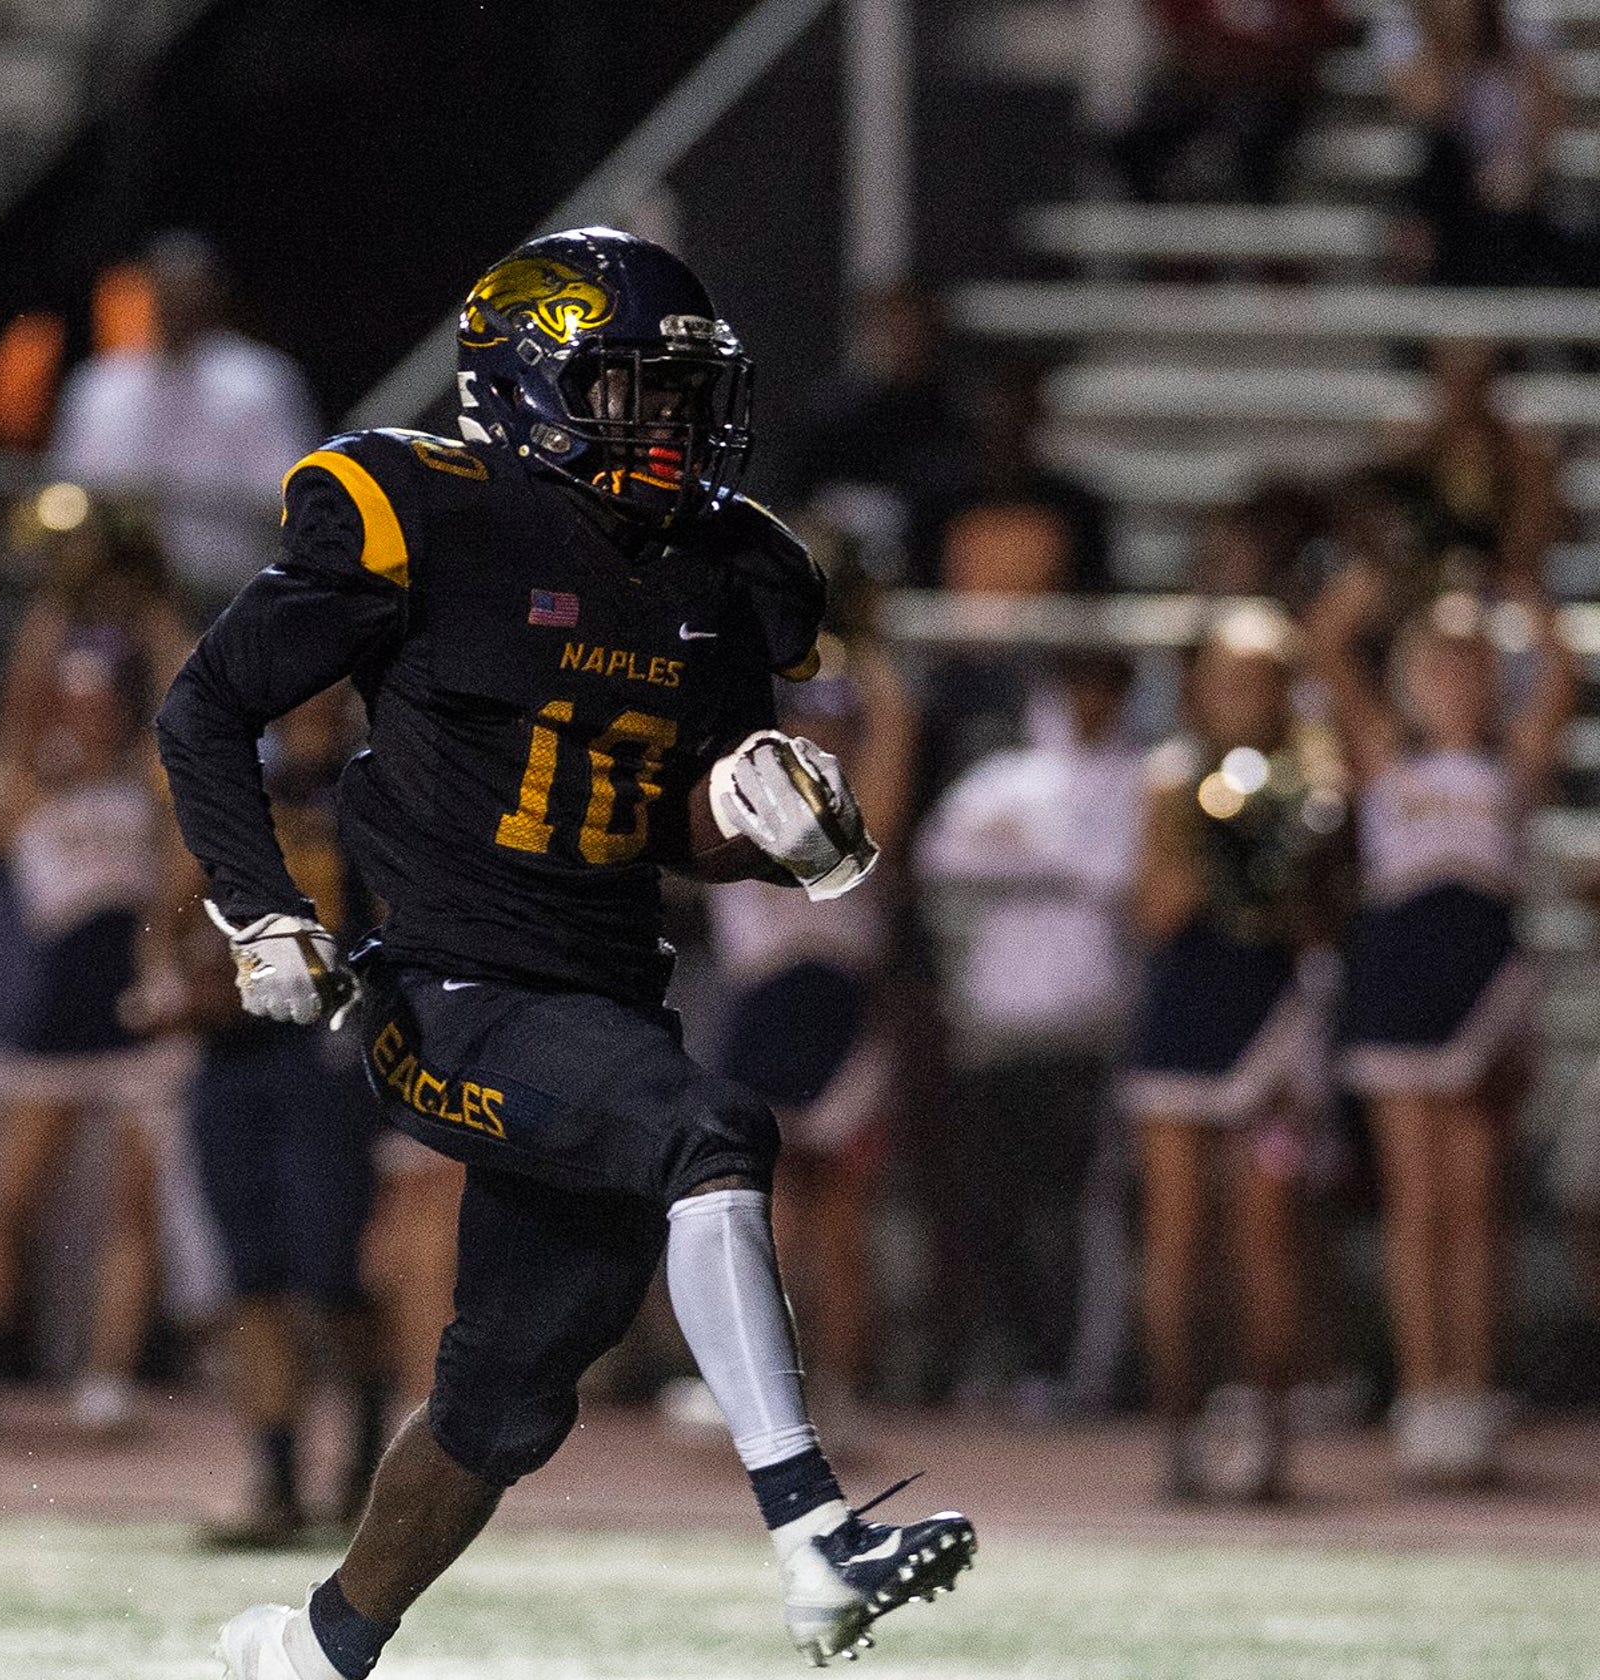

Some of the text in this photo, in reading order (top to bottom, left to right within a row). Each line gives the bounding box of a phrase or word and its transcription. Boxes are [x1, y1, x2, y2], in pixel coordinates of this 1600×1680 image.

[559, 642, 685, 688] NAPLES
[494, 699, 678, 864] 10
[373, 1021, 507, 1140] EAGLES
